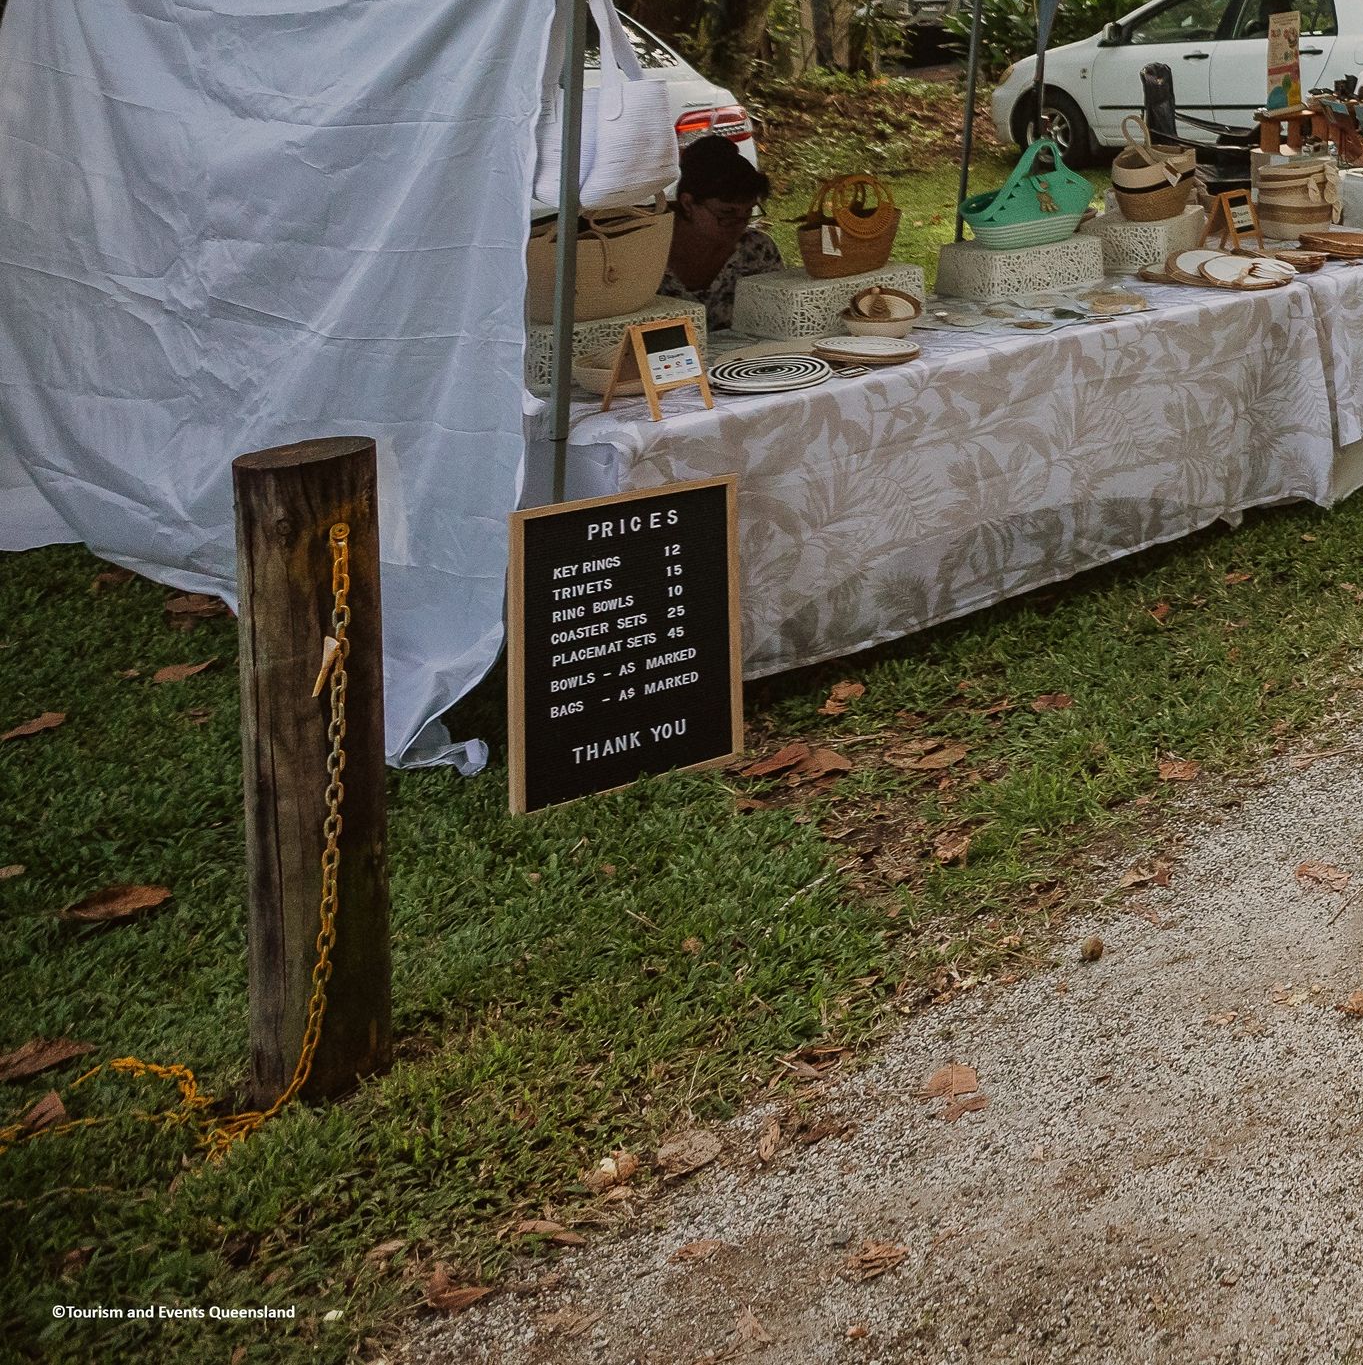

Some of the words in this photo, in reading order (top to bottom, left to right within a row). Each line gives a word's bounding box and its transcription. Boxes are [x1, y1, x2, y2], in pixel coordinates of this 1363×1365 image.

[587, 509, 679, 541] PRICES
[553, 564, 578, 580] KEY
[582, 556, 621, 574] RINGS
[664, 544, 681, 557] 12
[553, 579, 613, 601] TRIVETS
[666, 565, 683, 577] 15
[553, 606, 586, 623] RING
[593, 596, 634, 614] BOWLS
[668, 585, 683, 597] 10
[551, 623, 609, 645] COASTER
[617, 613, 648, 630] SETS
[667, 606, 685, 619] 25
[552, 641, 623, 667] PLACEMAT
[627, 633, 657, 649] SETS
[667, 626, 685, 639] 45
[551, 673, 596, 693] BOWLS
[619, 663, 636, 677] AS
[646, 648, 696, 671] MARKED
[550, 702, 584, 719] BAGS
[645, 672, 699, 695] MARKED
[572, 732, 641, 764] THANK
[651, 719, 686, 743] YOU
